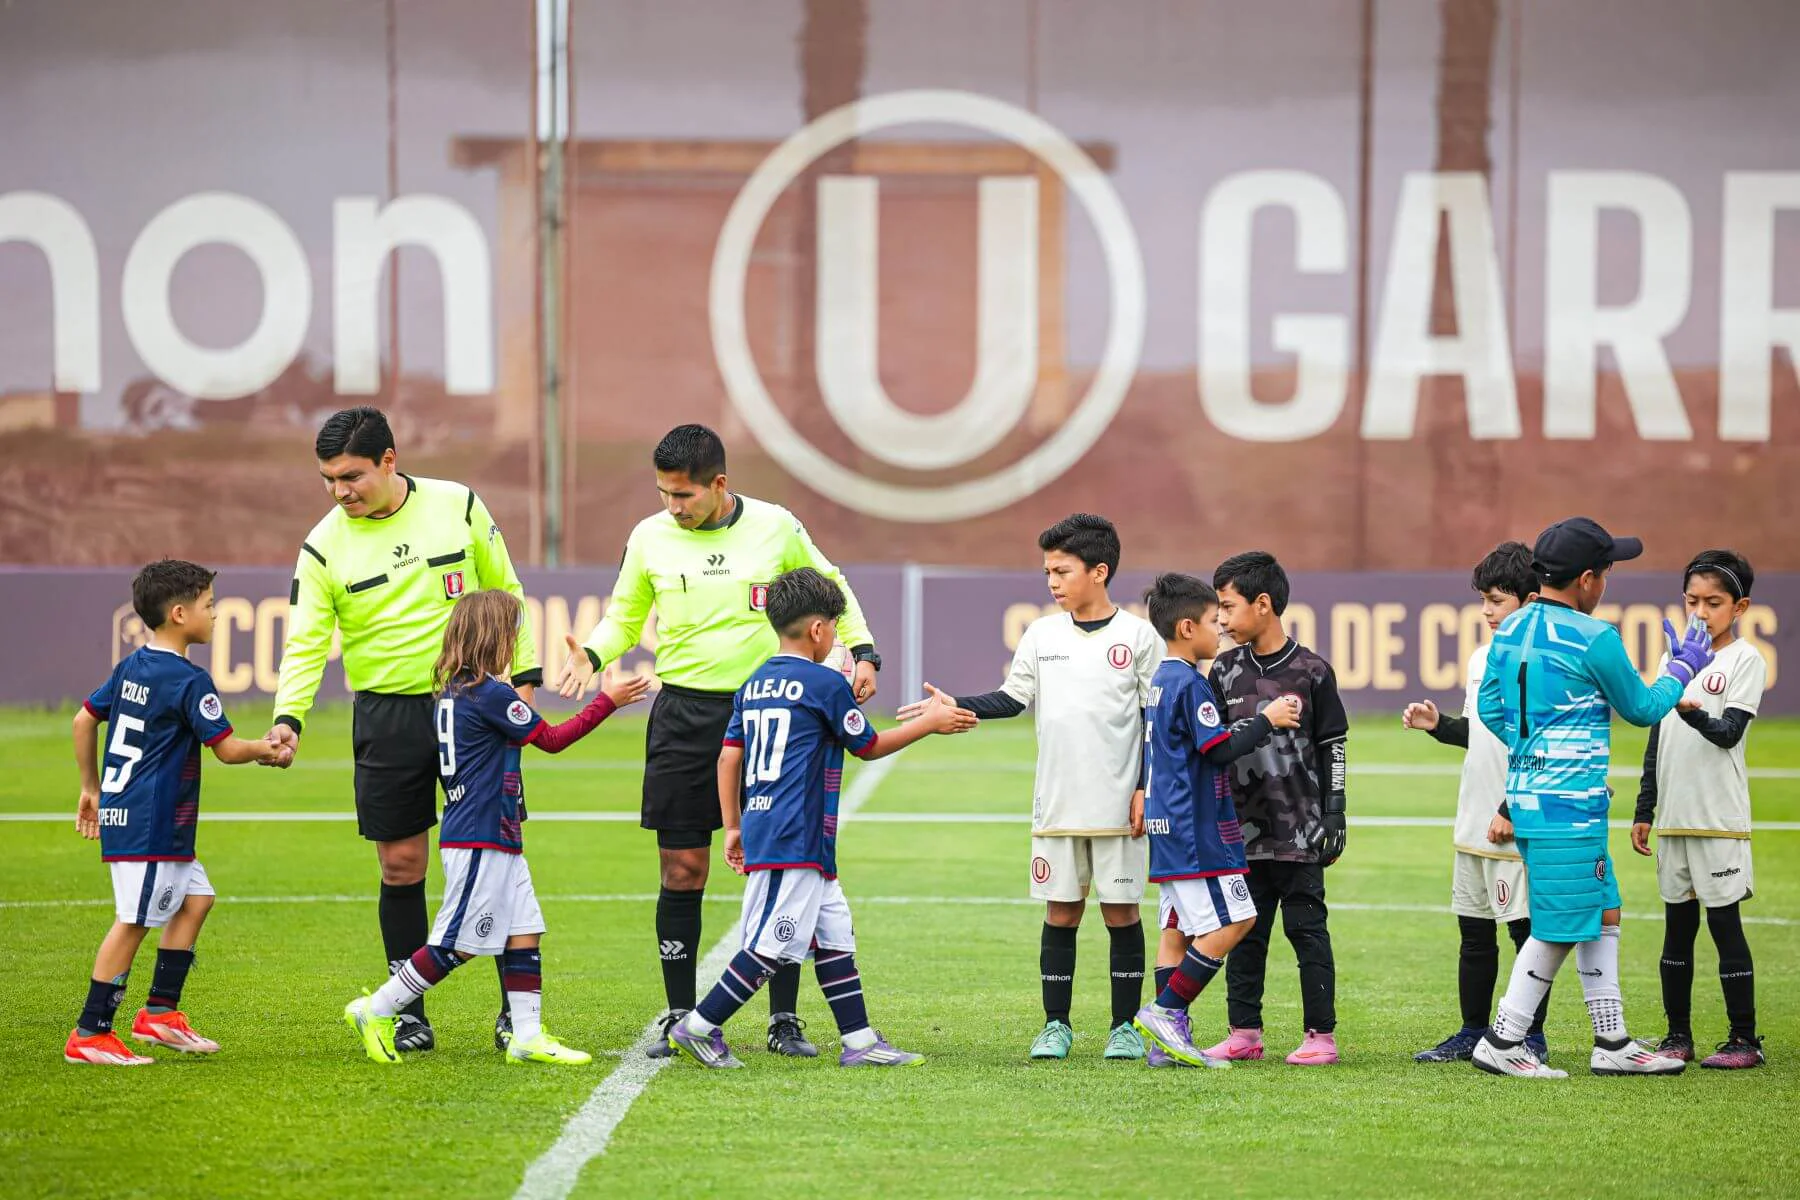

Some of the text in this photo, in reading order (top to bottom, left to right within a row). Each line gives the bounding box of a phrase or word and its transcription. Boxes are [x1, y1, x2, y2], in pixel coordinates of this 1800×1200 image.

[816, 176, 1040, 469] U
[743, 678, 804, 702] ALEJO
[1517, 662, 1529, 738] 1
[102, 714, 145, 793] 5
[438, 699, 456, 776] 9
